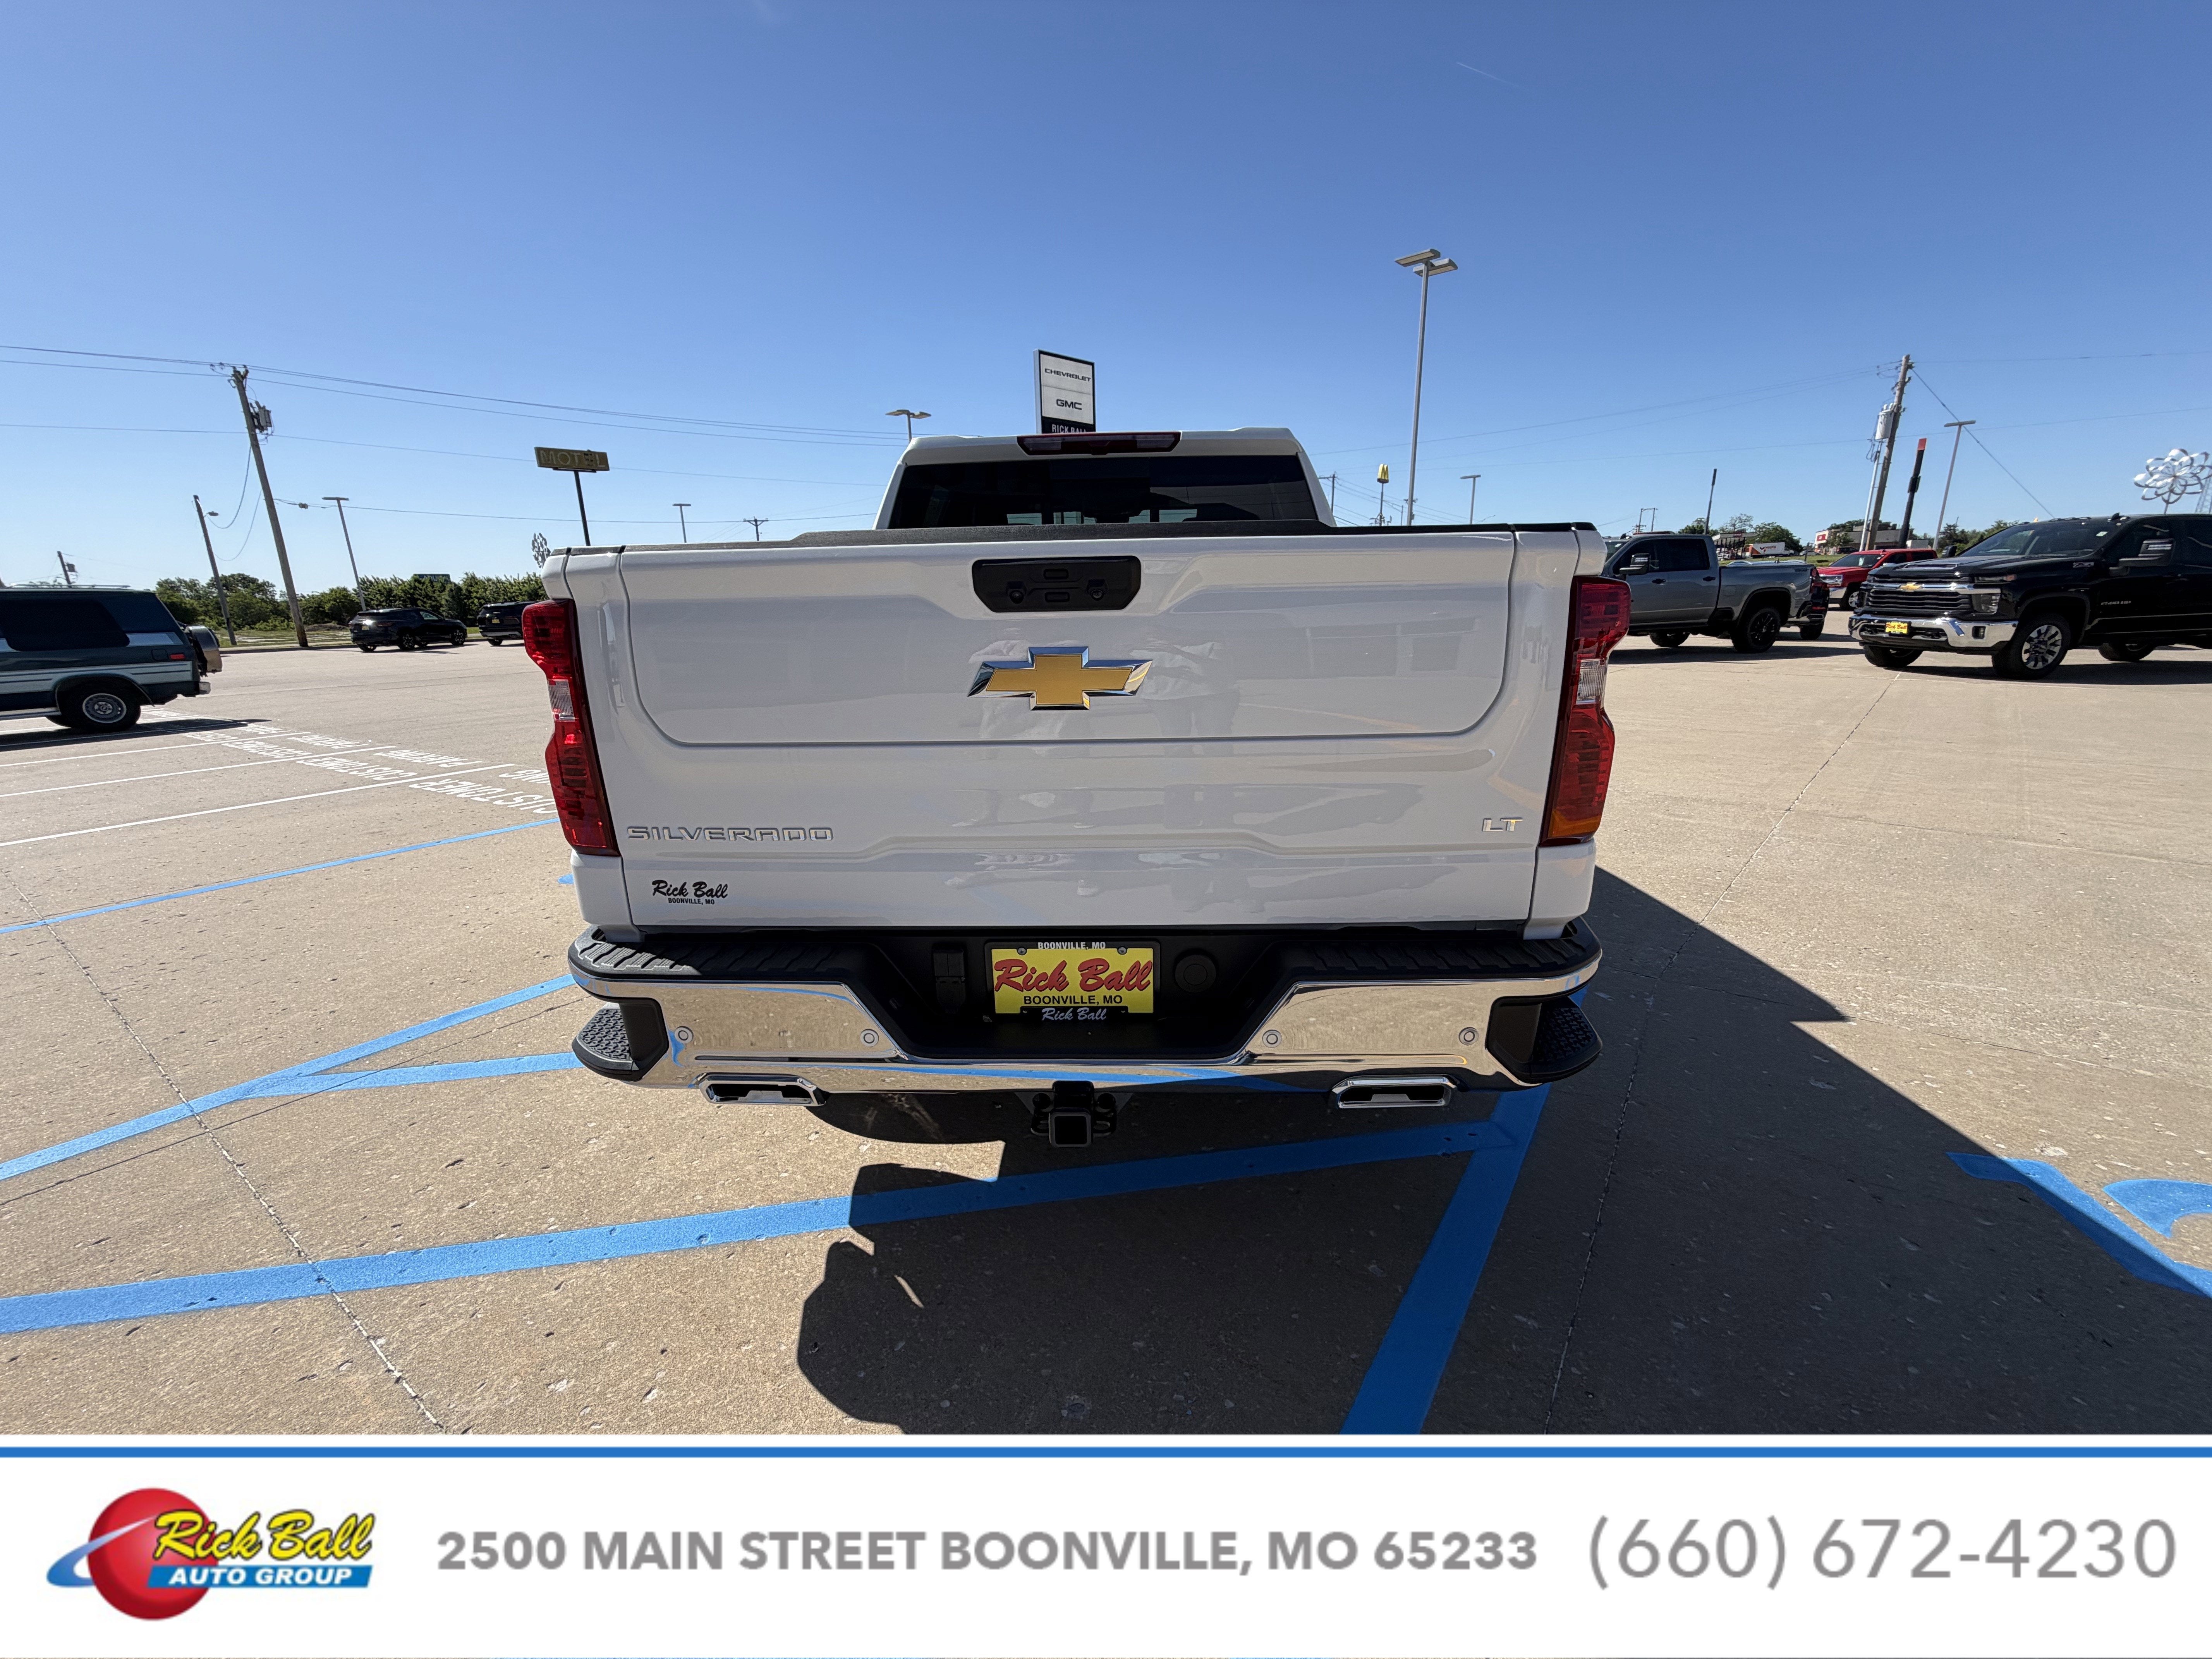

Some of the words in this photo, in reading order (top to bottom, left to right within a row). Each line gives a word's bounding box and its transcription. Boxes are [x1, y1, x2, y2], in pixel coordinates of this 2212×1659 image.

[1045, 368, 1091, 382] CHEVROLET
[1056, 399, 1082, 410] GMC
[1052, 424, 1069, 433] RICK
[221, 740, 312, 758] CUSTOMER
[373, 750, 483, 768] PARKING
[296, 756, 417, 781] CUSTOMER
[1482, 817, 1523, 832] LT
[627, 826, 834, 842] SILVERADO
[651, 879, 689, 898] Rick
[692, 881, 728, 899] Ball
[1038, 941, 1089, 950] BOONVILLE,
[994, 958, 1070, 993] Rick
[1078, 958, 1153, 992] Ball
[1024, 995, 1100, 1006] BOONVILLE,
[1103, 995, 1123, 1004] MO
[1042, 1008, 1073, 1021] Rick
[1077, 1007, 1107, 1021] Ball
